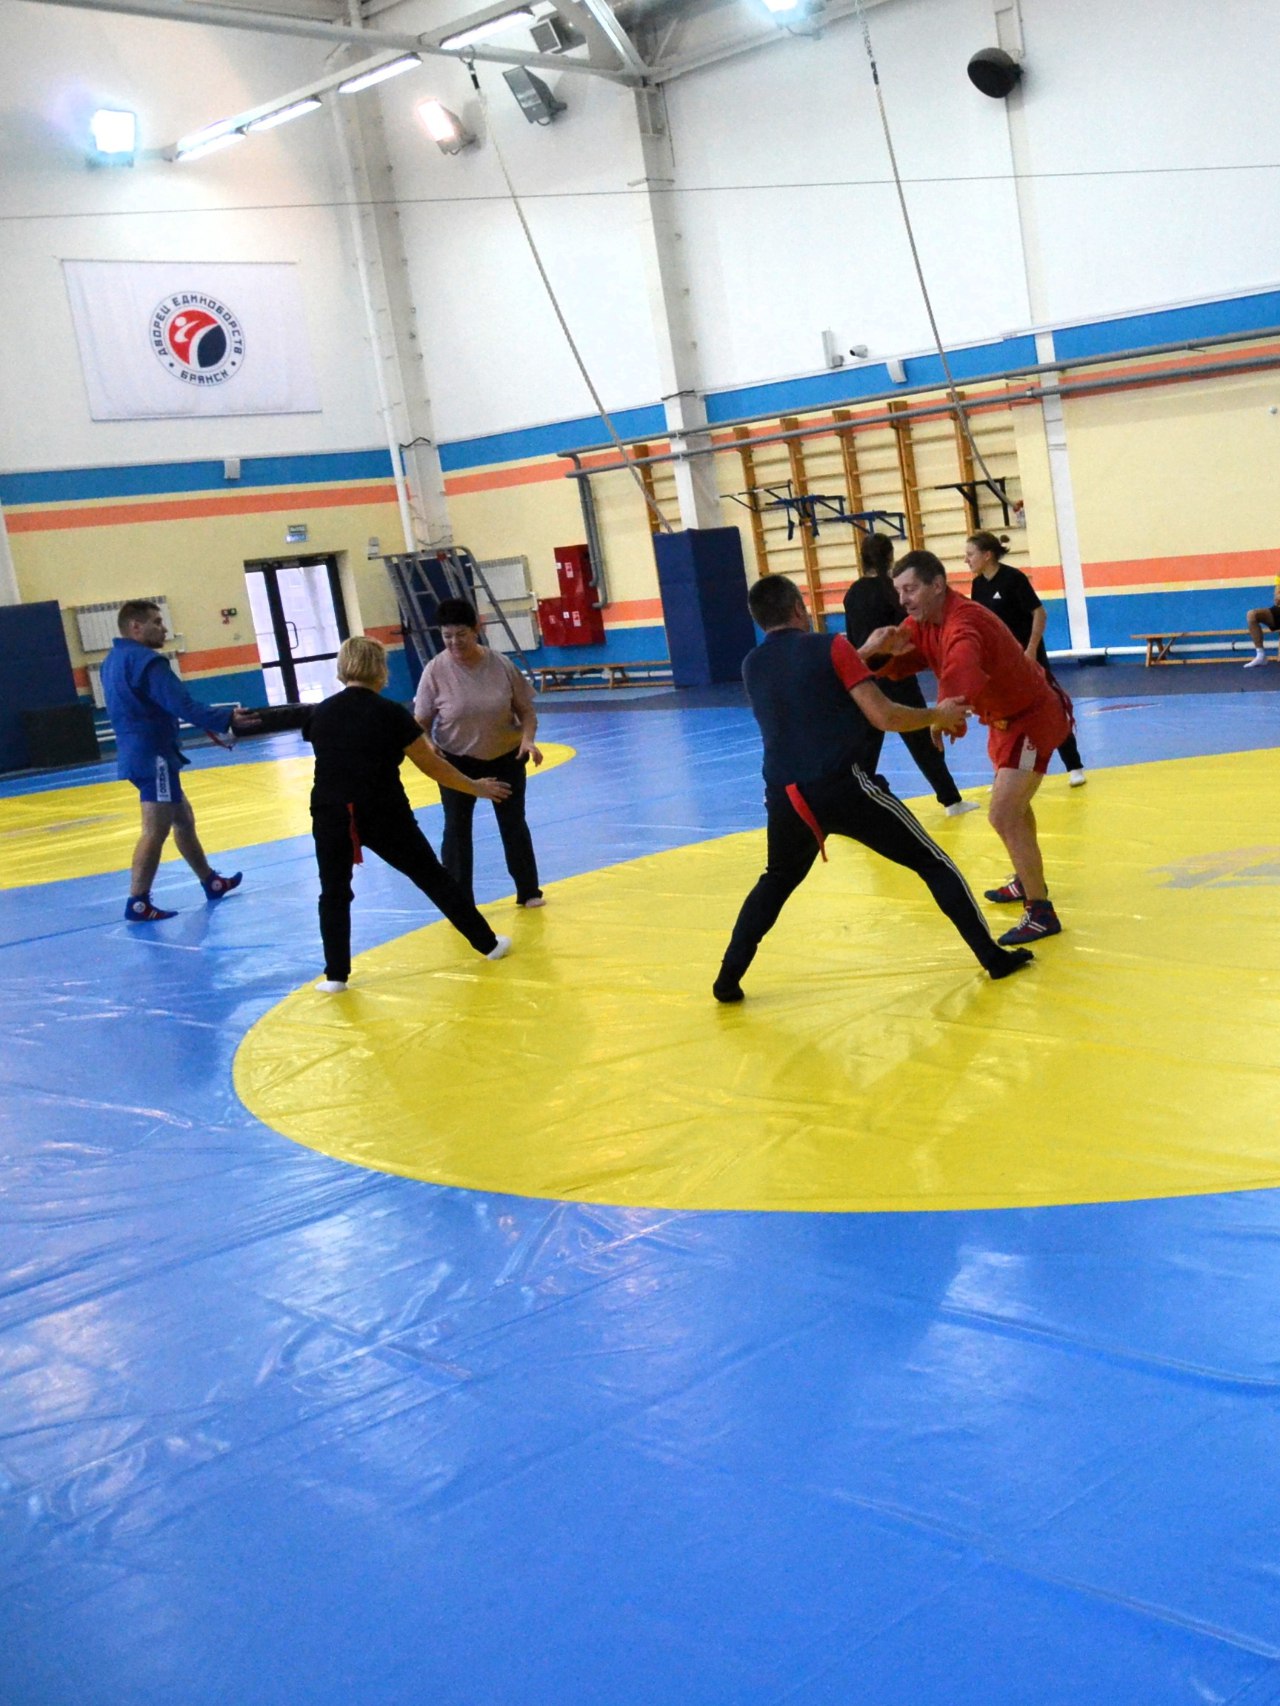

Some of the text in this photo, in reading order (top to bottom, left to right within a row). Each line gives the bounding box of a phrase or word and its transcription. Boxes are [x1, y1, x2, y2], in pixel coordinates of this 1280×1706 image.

[153, 294, 242, 356] ДВОРЕЦ ЕДИНОБОРСТВ
[180, 369, 229, 384] БРЯНСК
